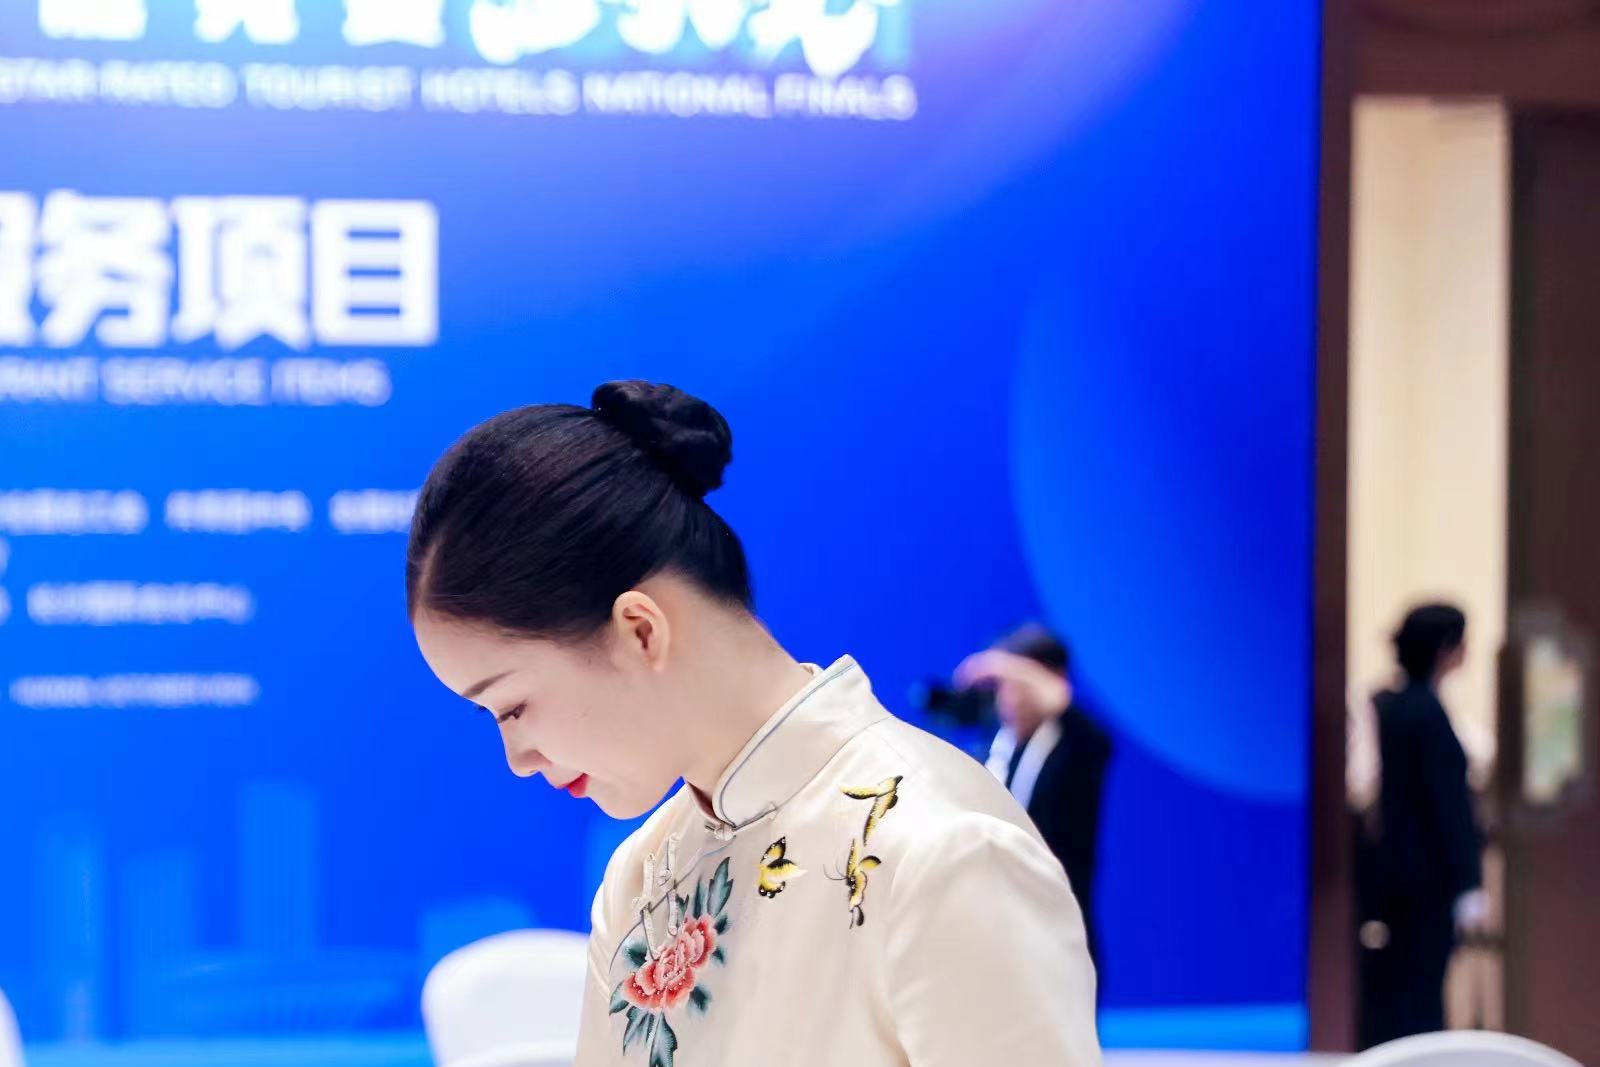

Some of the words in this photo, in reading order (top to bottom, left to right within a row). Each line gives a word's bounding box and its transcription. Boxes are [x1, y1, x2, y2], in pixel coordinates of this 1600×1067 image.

[244, 62, 414, 112] TOURIST
[420, 66, 580, 116] HOTELS
[583, 70, 773, 118] NATIONAL
[774, 74, 917, 120] FINALS
[102, 356, 266, 405] SERVICE
[269, 357, 392, 406] ITEMS
